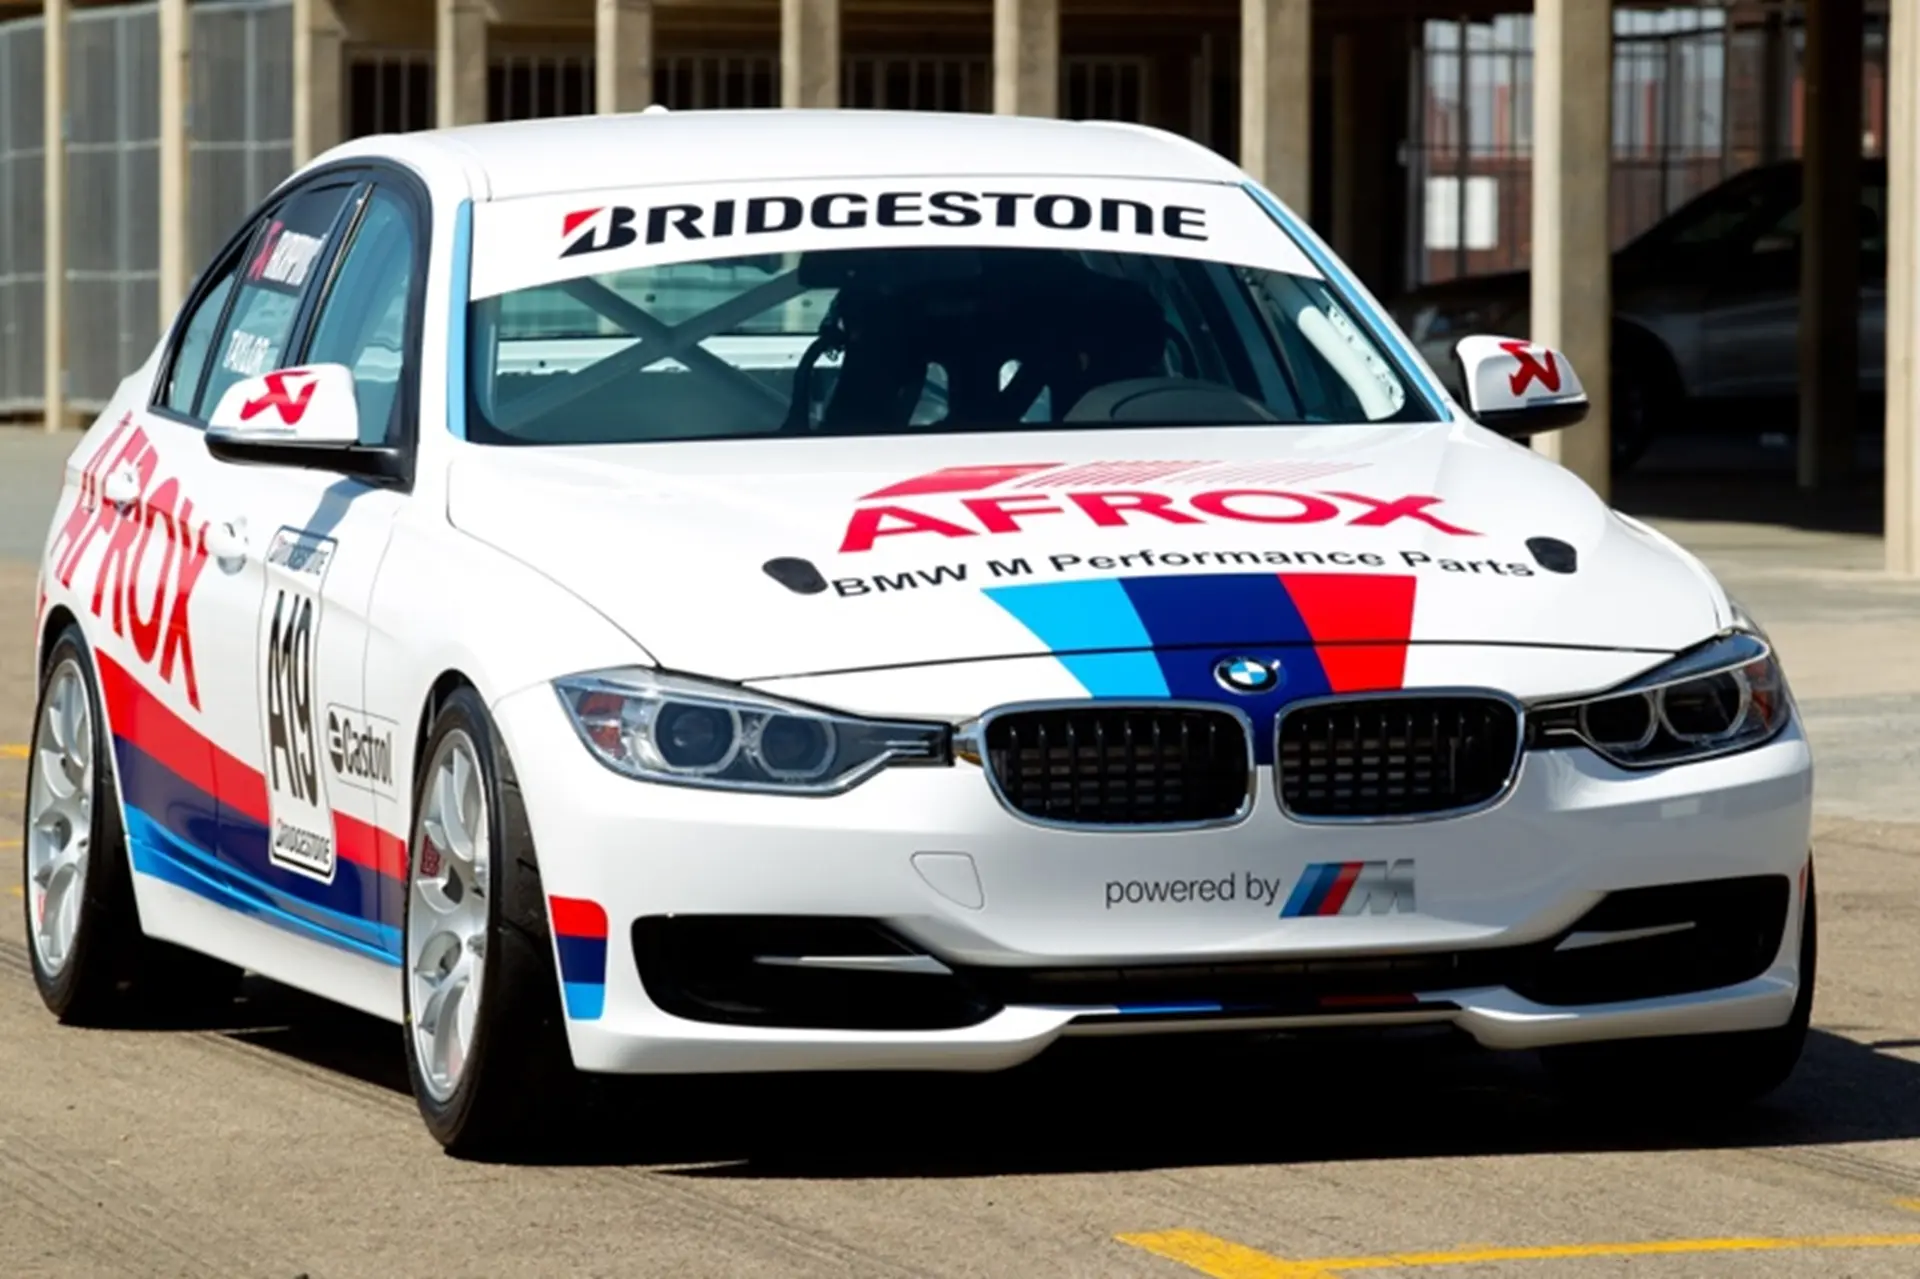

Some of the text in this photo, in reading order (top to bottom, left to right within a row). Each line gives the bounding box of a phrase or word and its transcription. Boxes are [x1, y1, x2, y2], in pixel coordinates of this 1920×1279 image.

[559, 191, 1208, 260] BRIDGESTONE
[837, 489, 1486, 554] AFROX
[50, 409, 210, 713] AFROX
[832, 549, 1535, 598] BMW M Performance Parts
[342, 717, 393, 787] Castrol
[1105, 872, 1236, 909] powered
[1245, 871, 1281, 907] by
